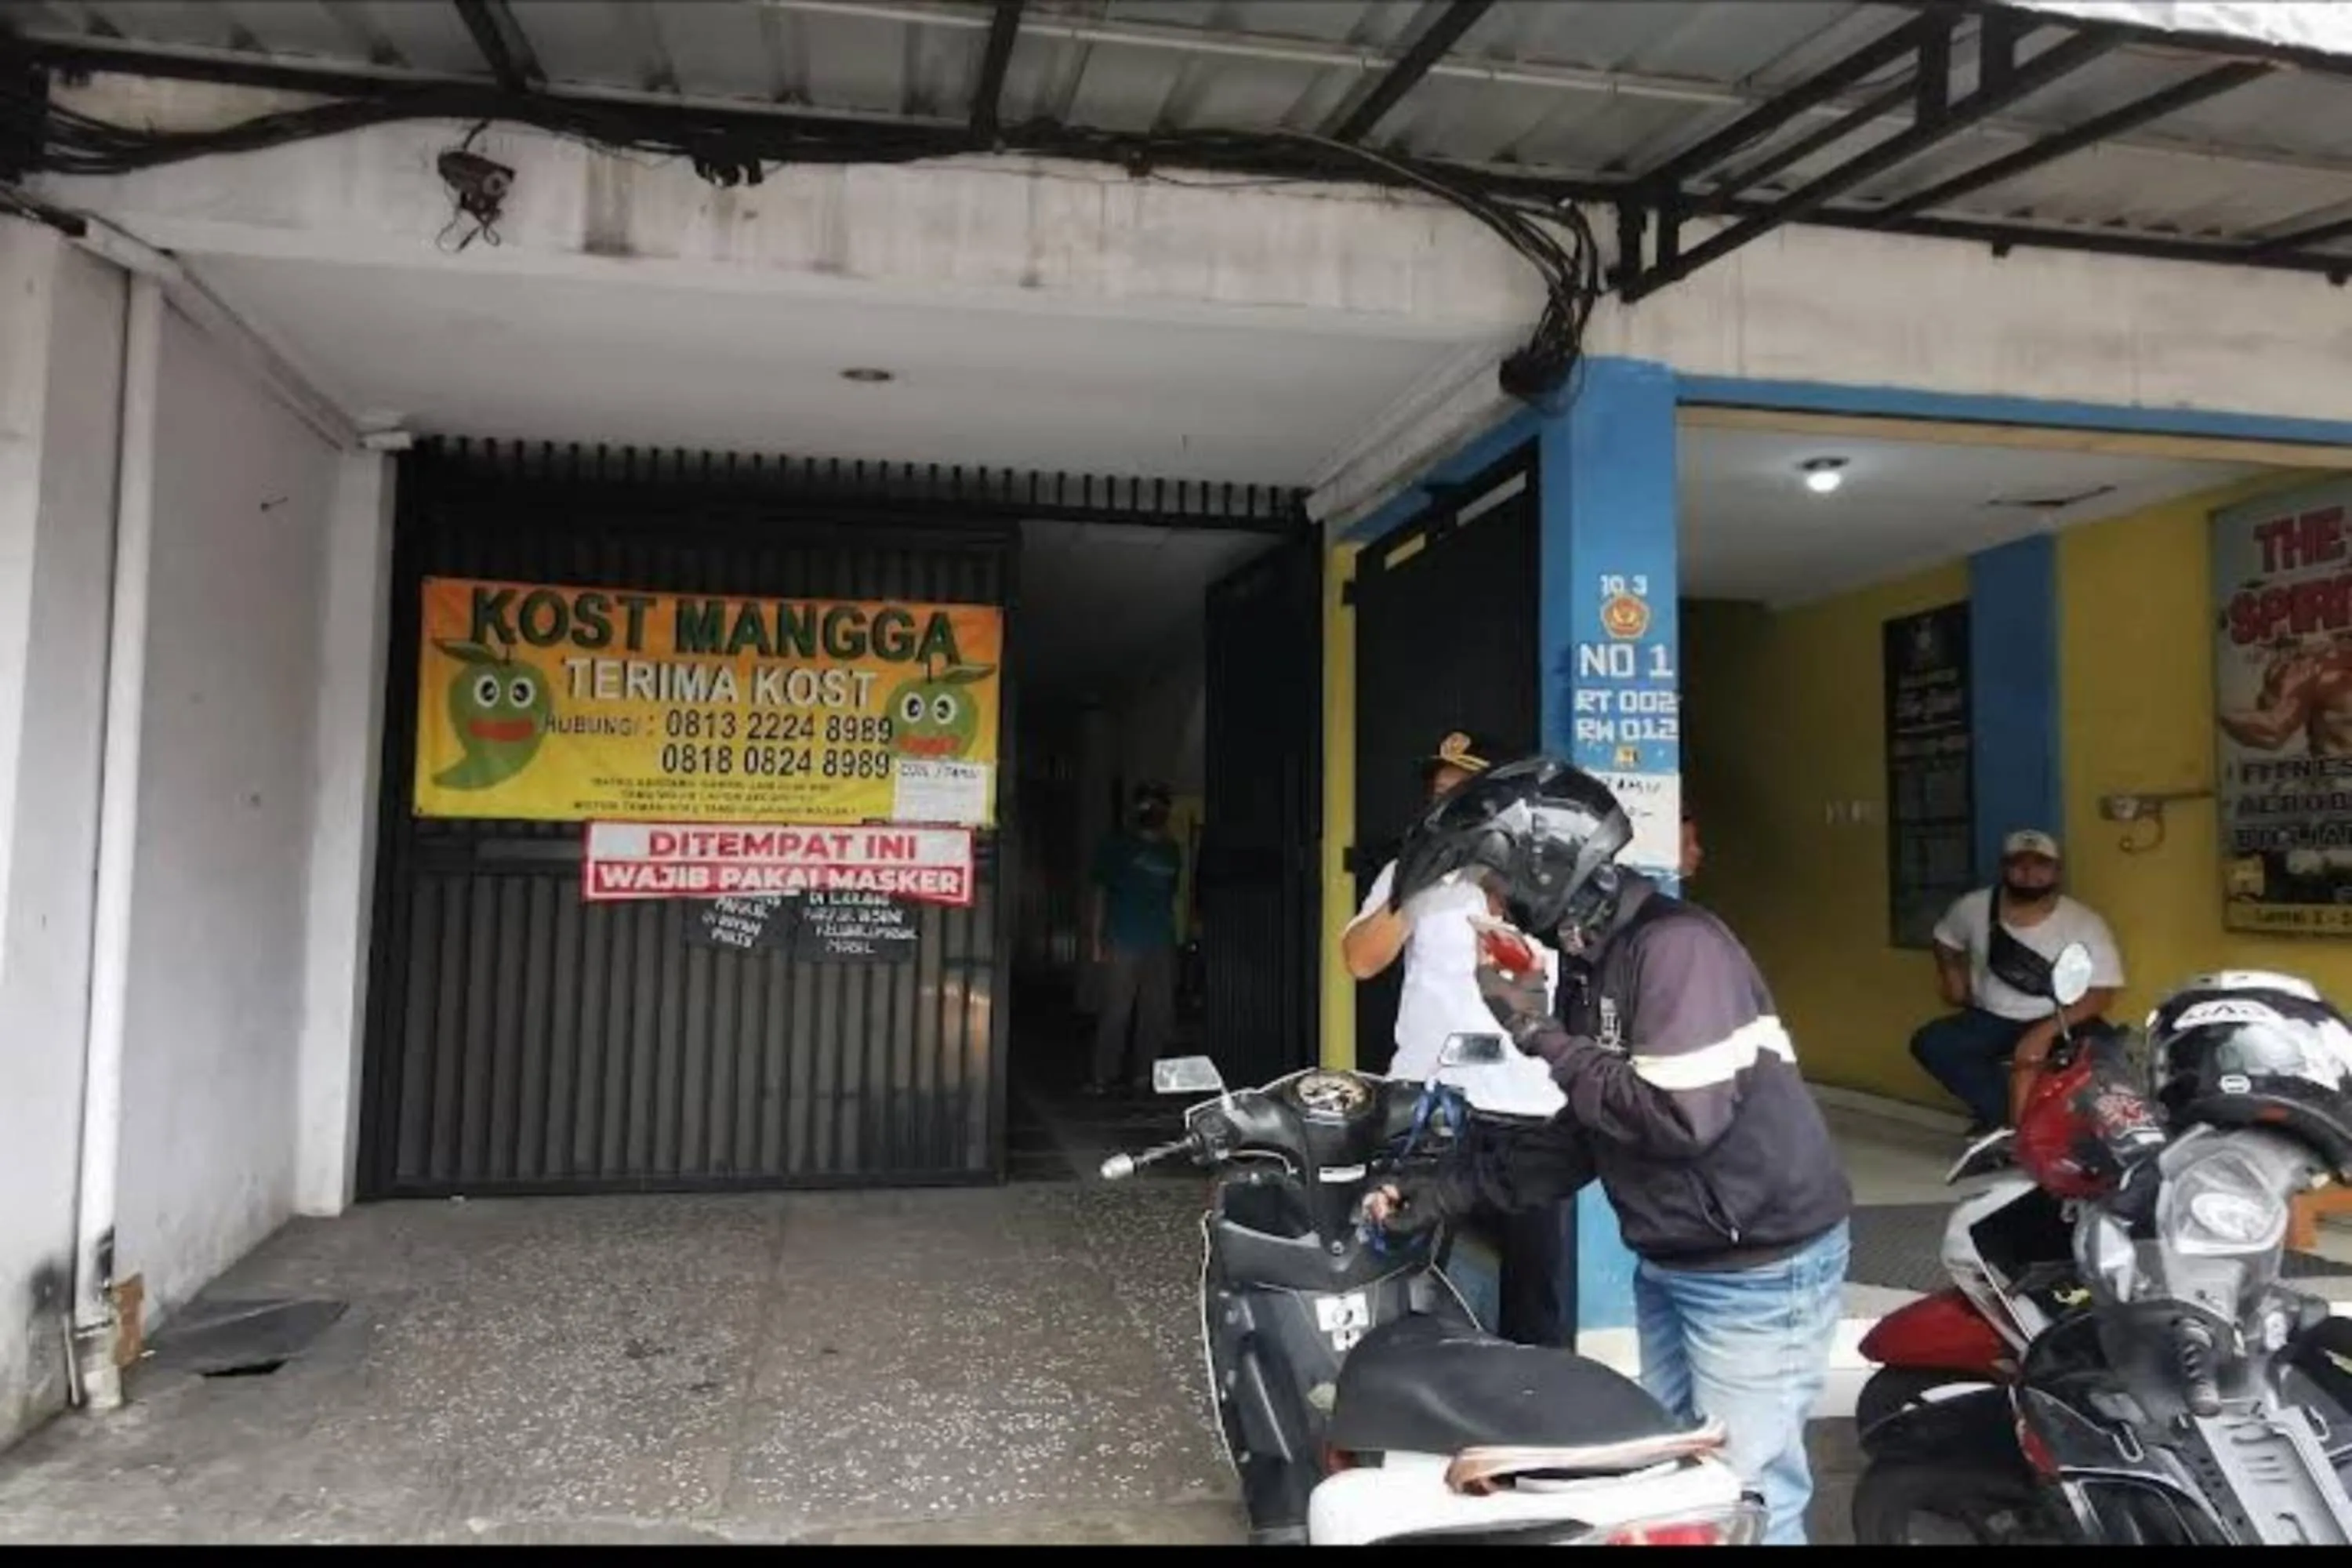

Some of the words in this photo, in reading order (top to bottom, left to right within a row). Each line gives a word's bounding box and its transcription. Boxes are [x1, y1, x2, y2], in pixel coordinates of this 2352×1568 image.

[2252, 506, 2345, 574] THE
[470, 587, 658, 651] KOST
[675, 597, 961, 664] MANGGA
[1580, 643, 1635, 678] NO
[1649, 643, 1675, 678] 1
[561, 658, 739, 705] TERIMA
[753, 662, 879, 710] KOST
[1575, 689, 1613, 712] RT
[1618, 689, 1679, 713] 002
[666, 709, 738, 739] 0813
[746, 711, 815, 742] 2224
[826, 714, 894, 746] 8989
[1621, 717, 1679, 742] 012
[662, 742, 733, 775] 0818
[743, 746, 813, 777] 0824
[822, 748, 891, 779] 8989
[649, 829, 853, 859] DITEMPAT
[866, 834, 916, 860] INI
[599, 863, 710, 890] WAJIB
[719, 866, 818, 891] PAKAI
[826, 867, 964, 894] MASKER
